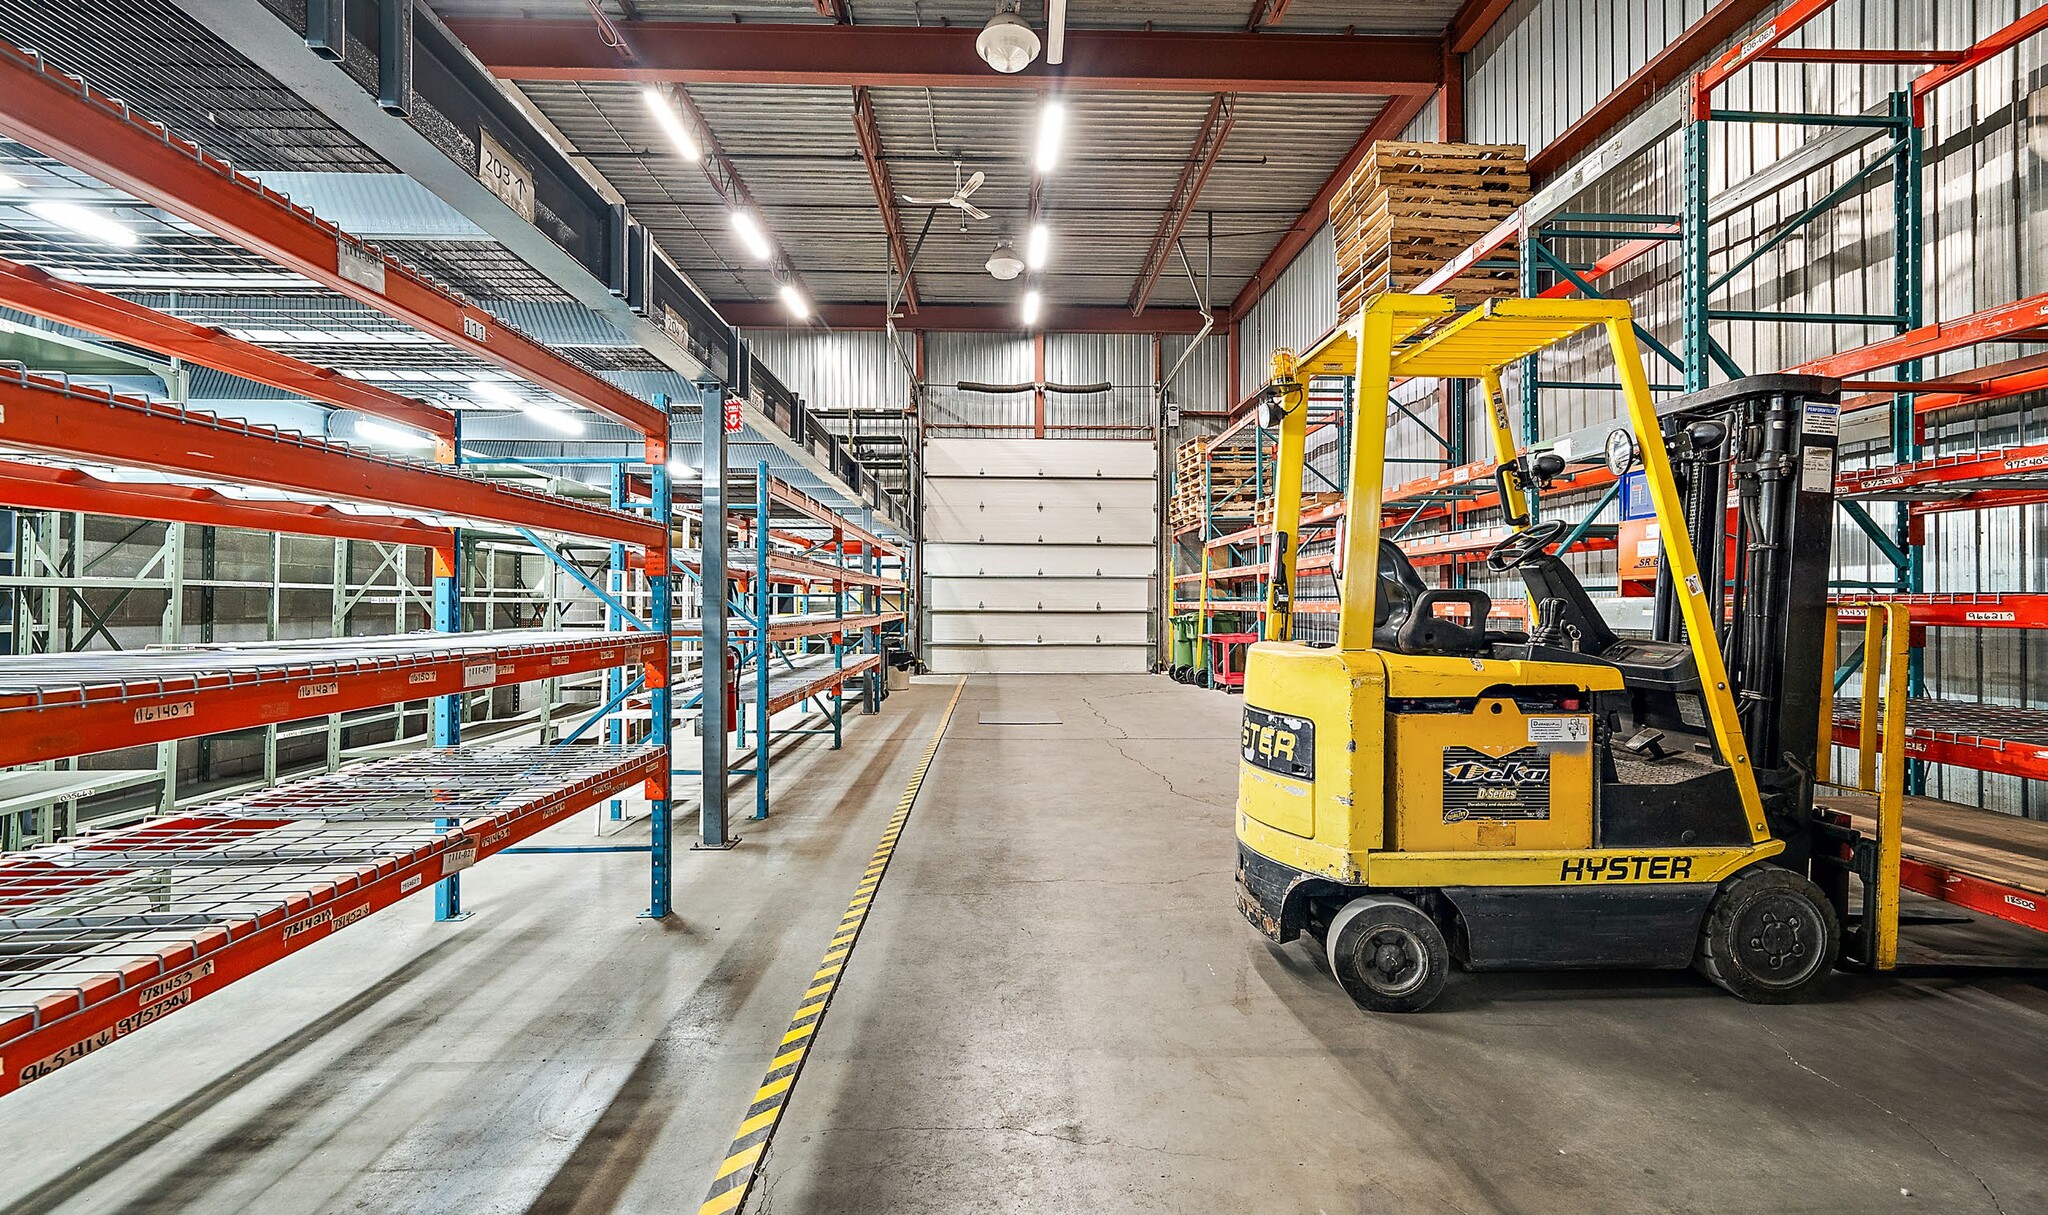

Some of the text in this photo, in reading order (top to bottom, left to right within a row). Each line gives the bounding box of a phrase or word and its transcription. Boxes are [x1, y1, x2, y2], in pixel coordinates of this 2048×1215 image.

[485, 150, 511, 186] 203
[465, 319, 485, 341] 111
[1639, 558, 1651, 567] SR
[135, 705, 180, 723] 116140
[1444, 761, 1549, 787] Deka
[1560, 856, 1693, 882] HYSTER
[142, 971, 192, 1002] 781453
[118, 995, 178, 1034] 975730
